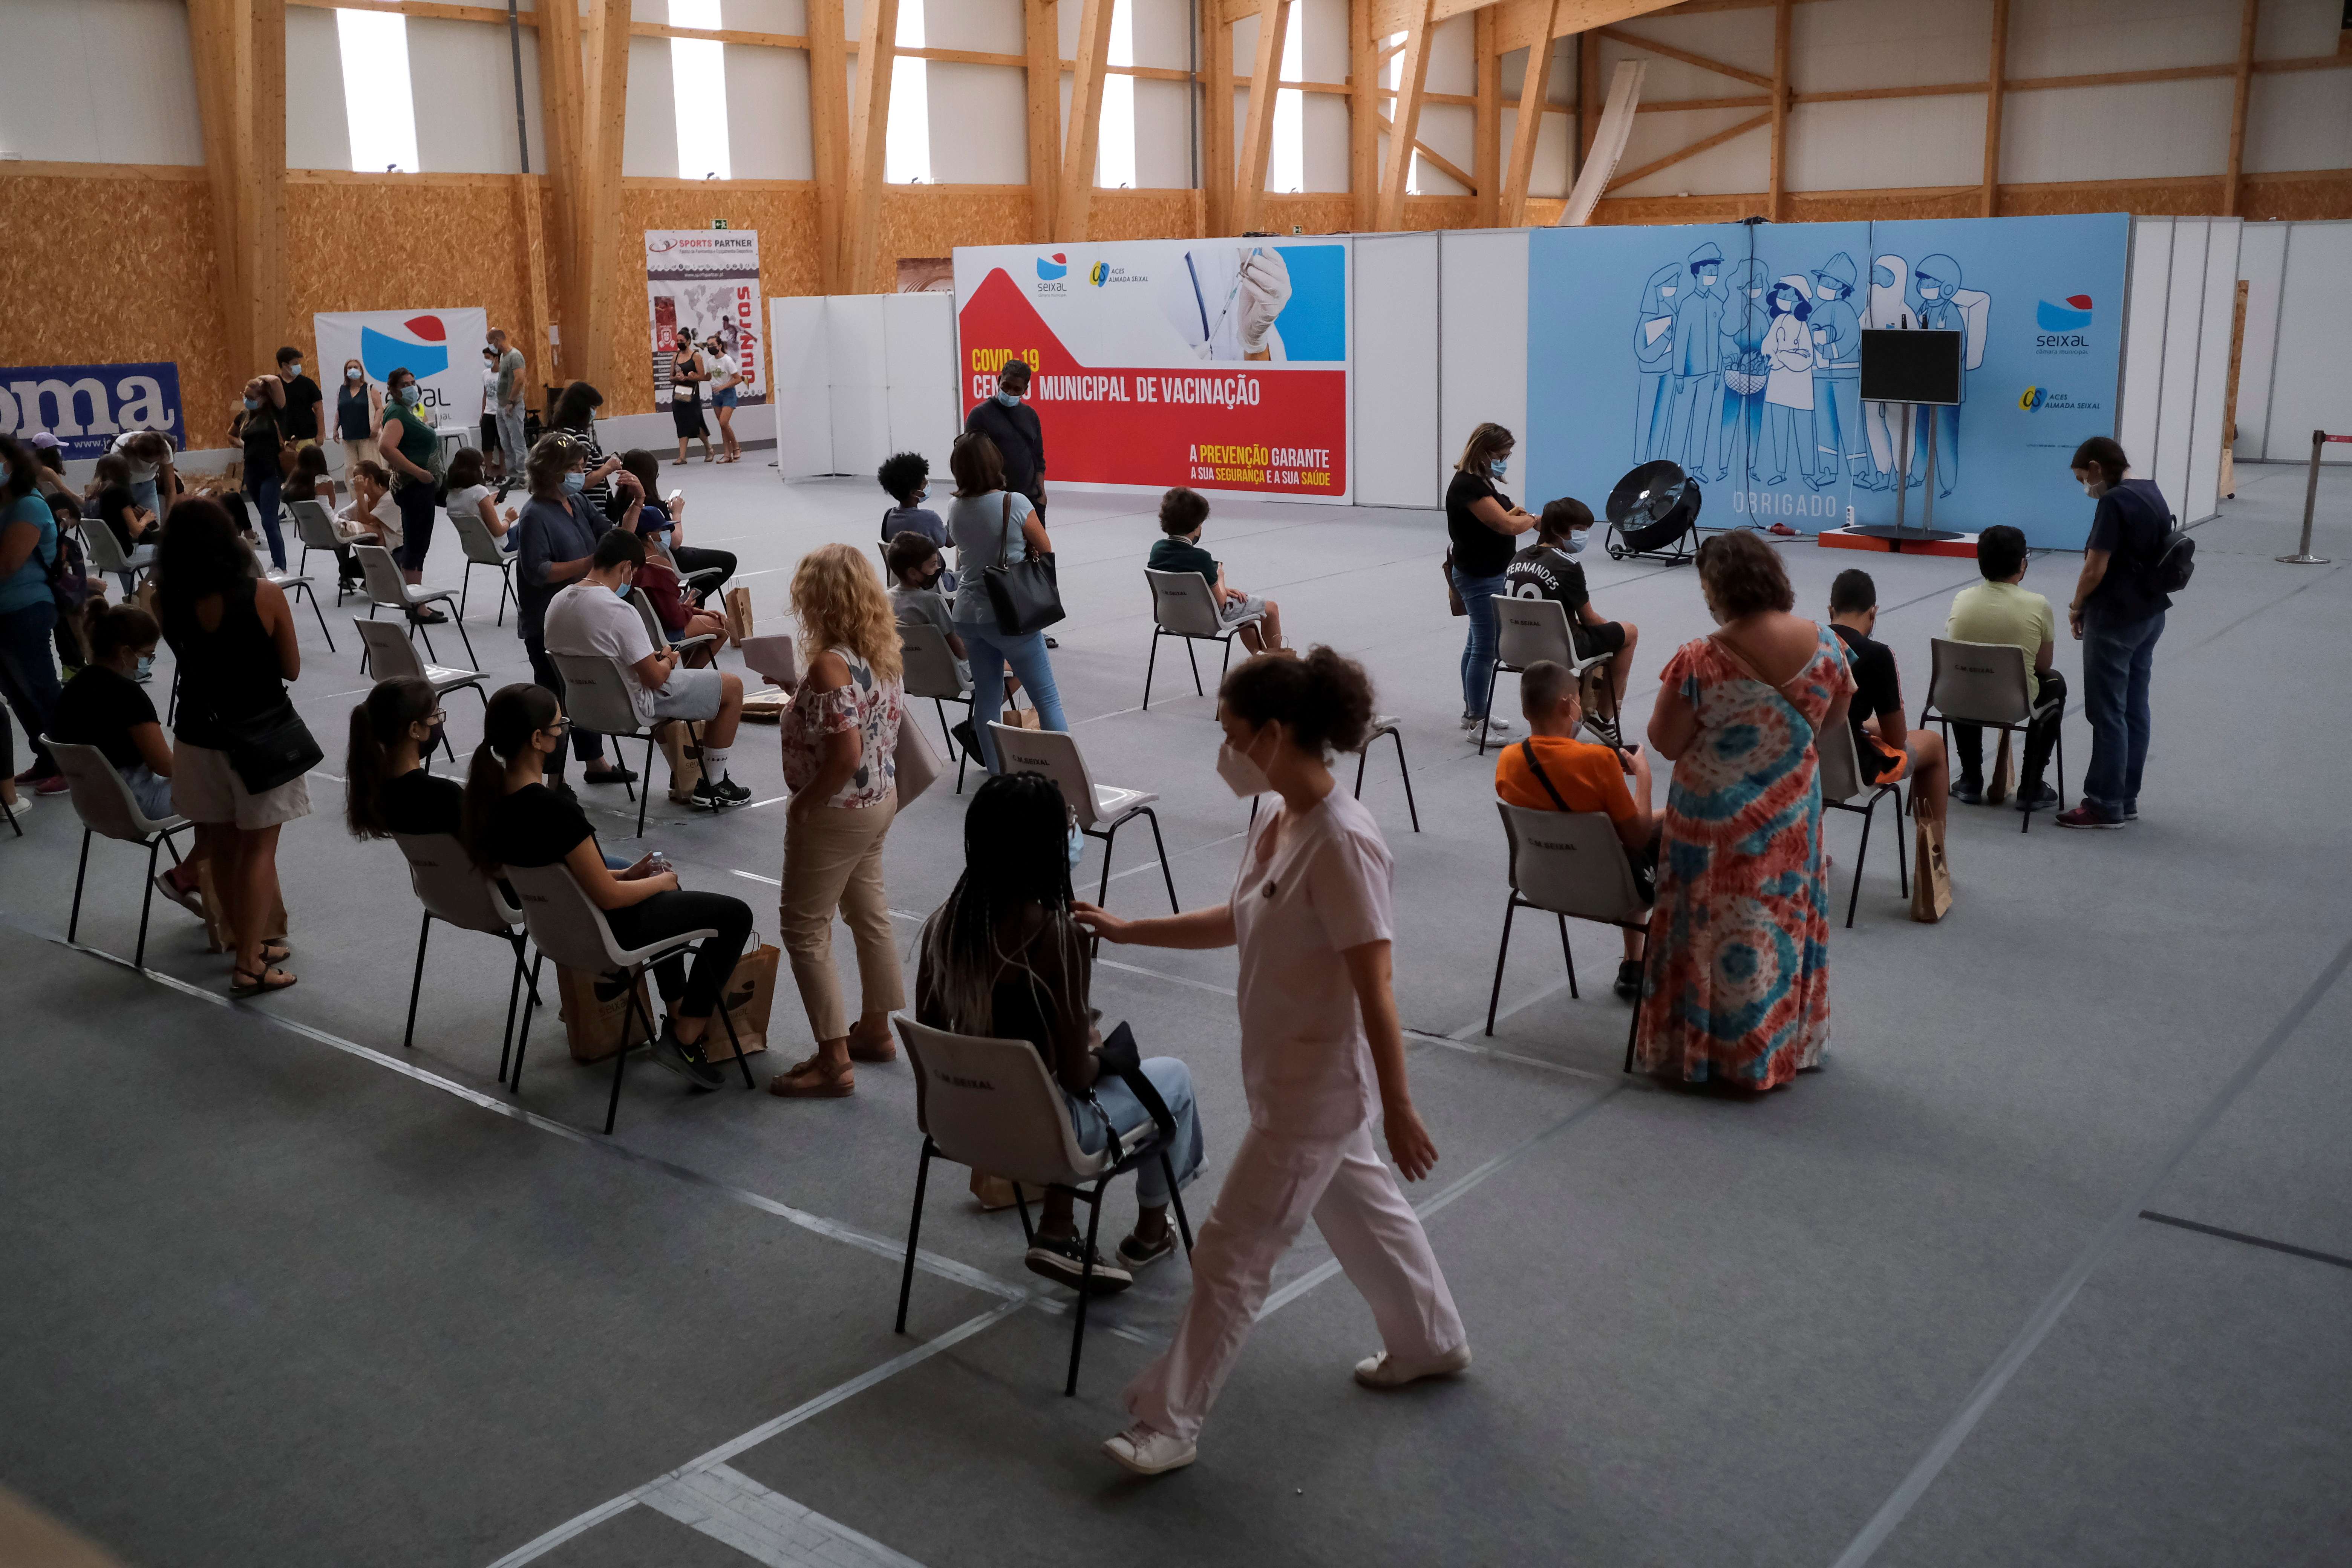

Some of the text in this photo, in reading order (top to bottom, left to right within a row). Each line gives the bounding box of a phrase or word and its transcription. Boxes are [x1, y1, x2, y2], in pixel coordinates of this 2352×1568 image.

[973, 374, 1260, 409] CENO MUNICIPAL DE VACINAÇÃO
[1190, 444, 1330, 468] A PREVENÇÃO GARANTE
[1191, 467, 1331, 485] A SUA SEGURANÇA E A SUA SAÚDE
[1734, 491, 1836, 517] OBRIGADO
[1507, 562, 1559, 590] FERNANDES
[686, 761, 701, 769] seix
